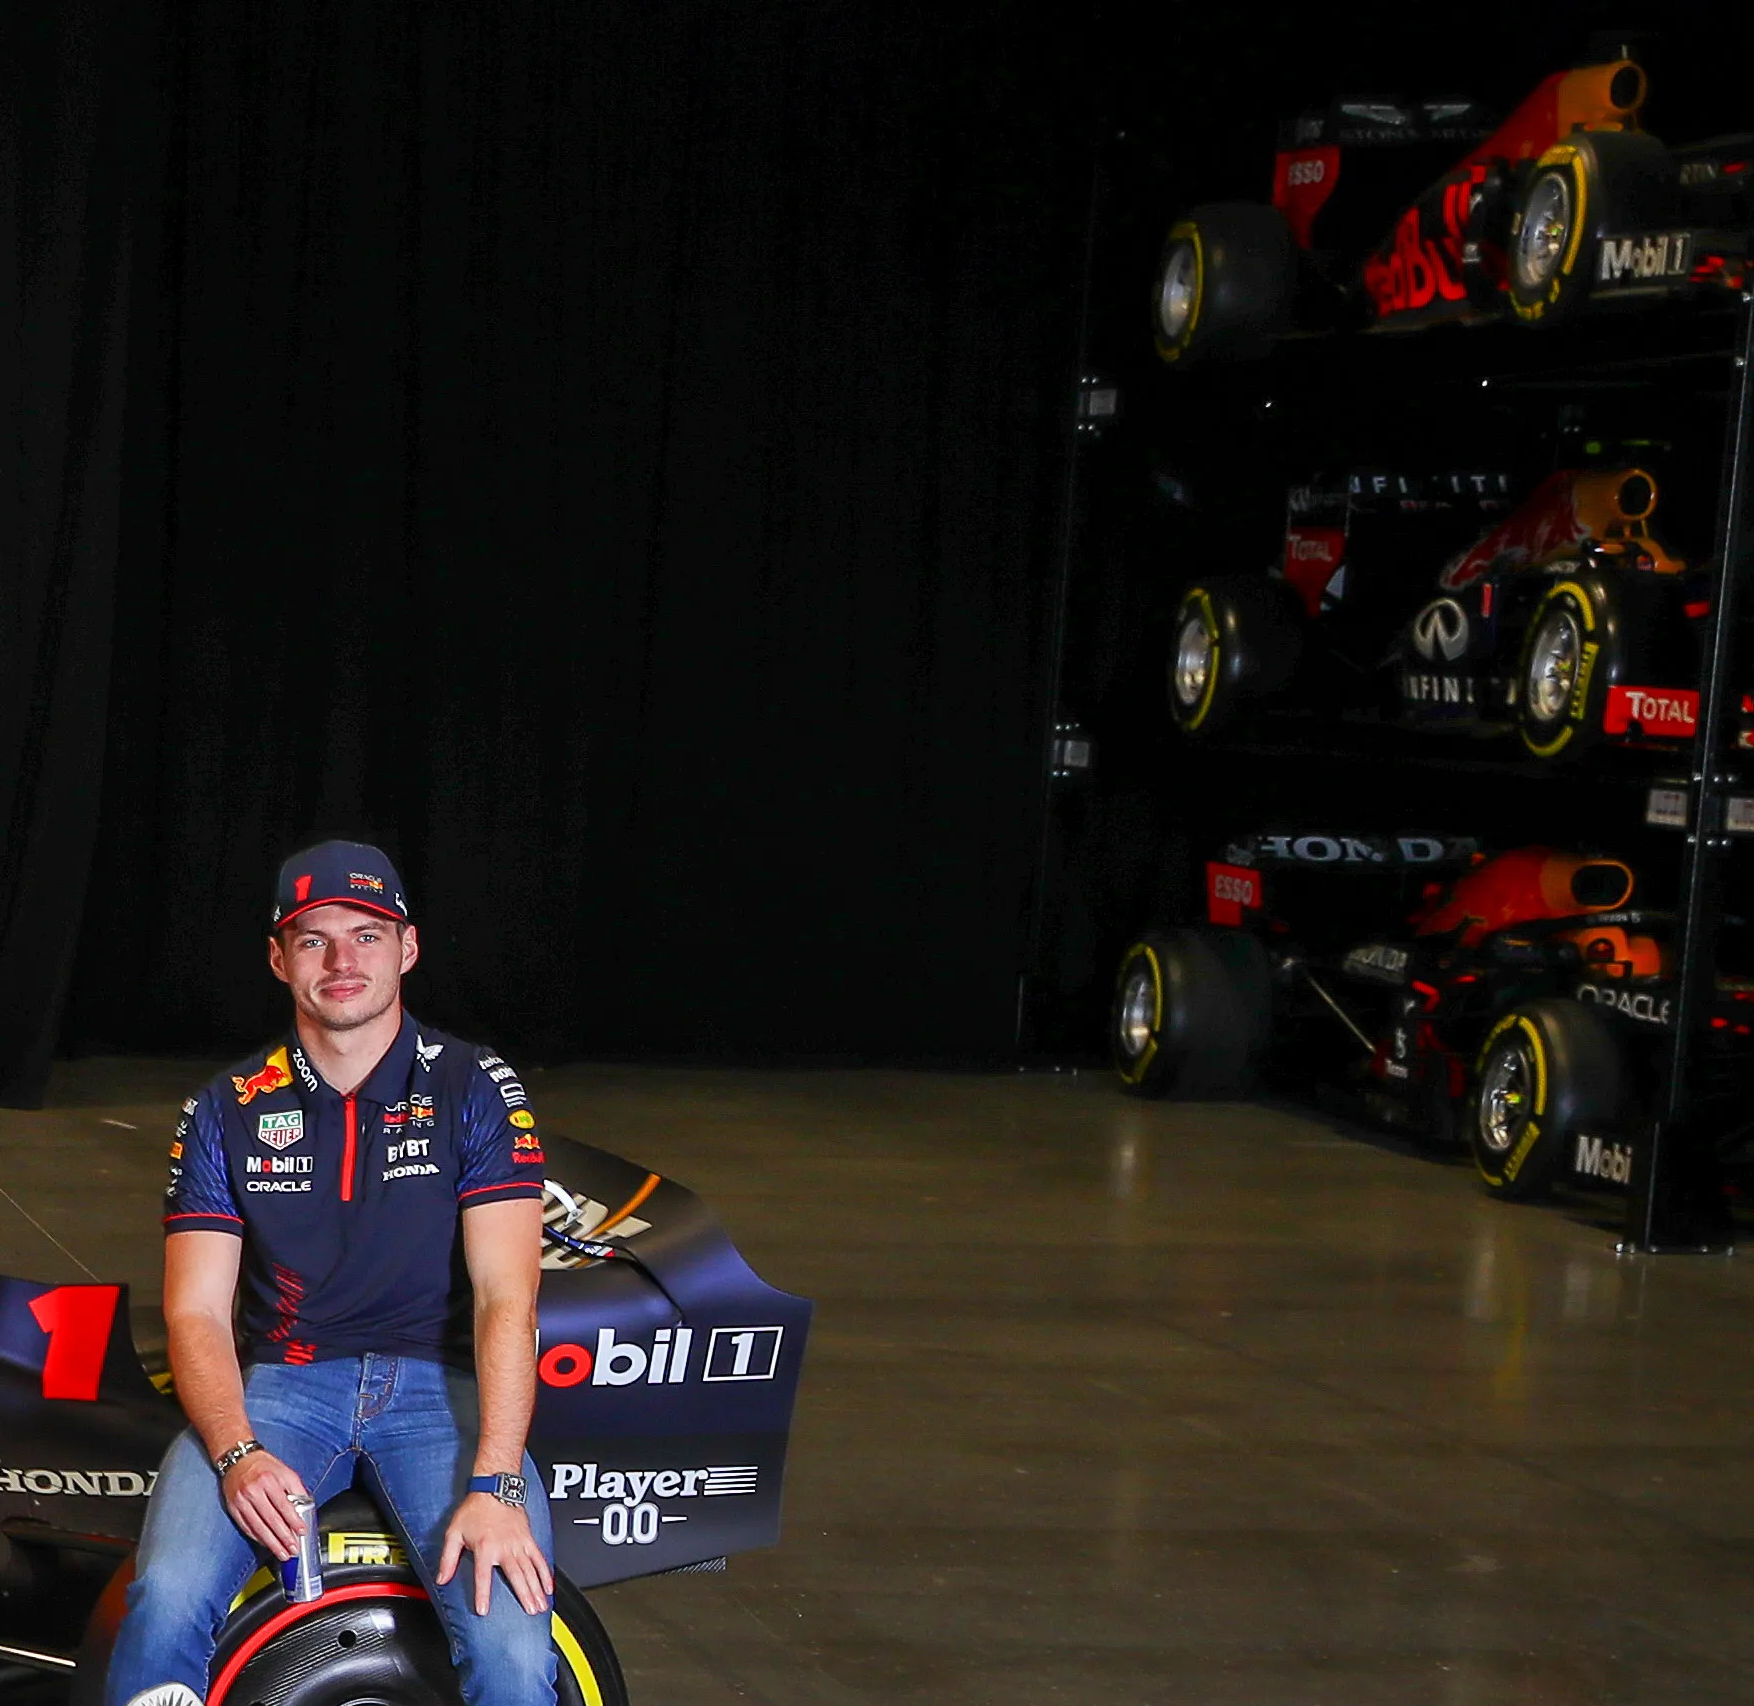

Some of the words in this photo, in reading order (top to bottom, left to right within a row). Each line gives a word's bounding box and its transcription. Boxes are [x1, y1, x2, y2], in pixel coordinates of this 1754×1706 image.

[1602, 235, 1666, 280] Mobil
[1625, 691, 1696, 725] TOTAL
[295, 874, 312, 902] 1
[1215, 874, 1254, 905] ESSO
[293, 1048, 319, 1092] zoom
[260, 1128, 301, 1147] HEUER
[264, 1114, 299, 1128] TAG
[246, 1157, 294, 1173] Mobil
[387, 1139, 430, 1163] BYBT
[1576, 1137, 1634, 1185] Mobi
[246, 1181, 312, 1193] ORACLE
[28, 1285, 120, 1401] 1
[535, 1327, 694, 1388] obil
[549, 1463, 711, 1508] Player
[600, 1501, 661, 1546] 0.0
[328, 1531, 410, 1565] PIRE
